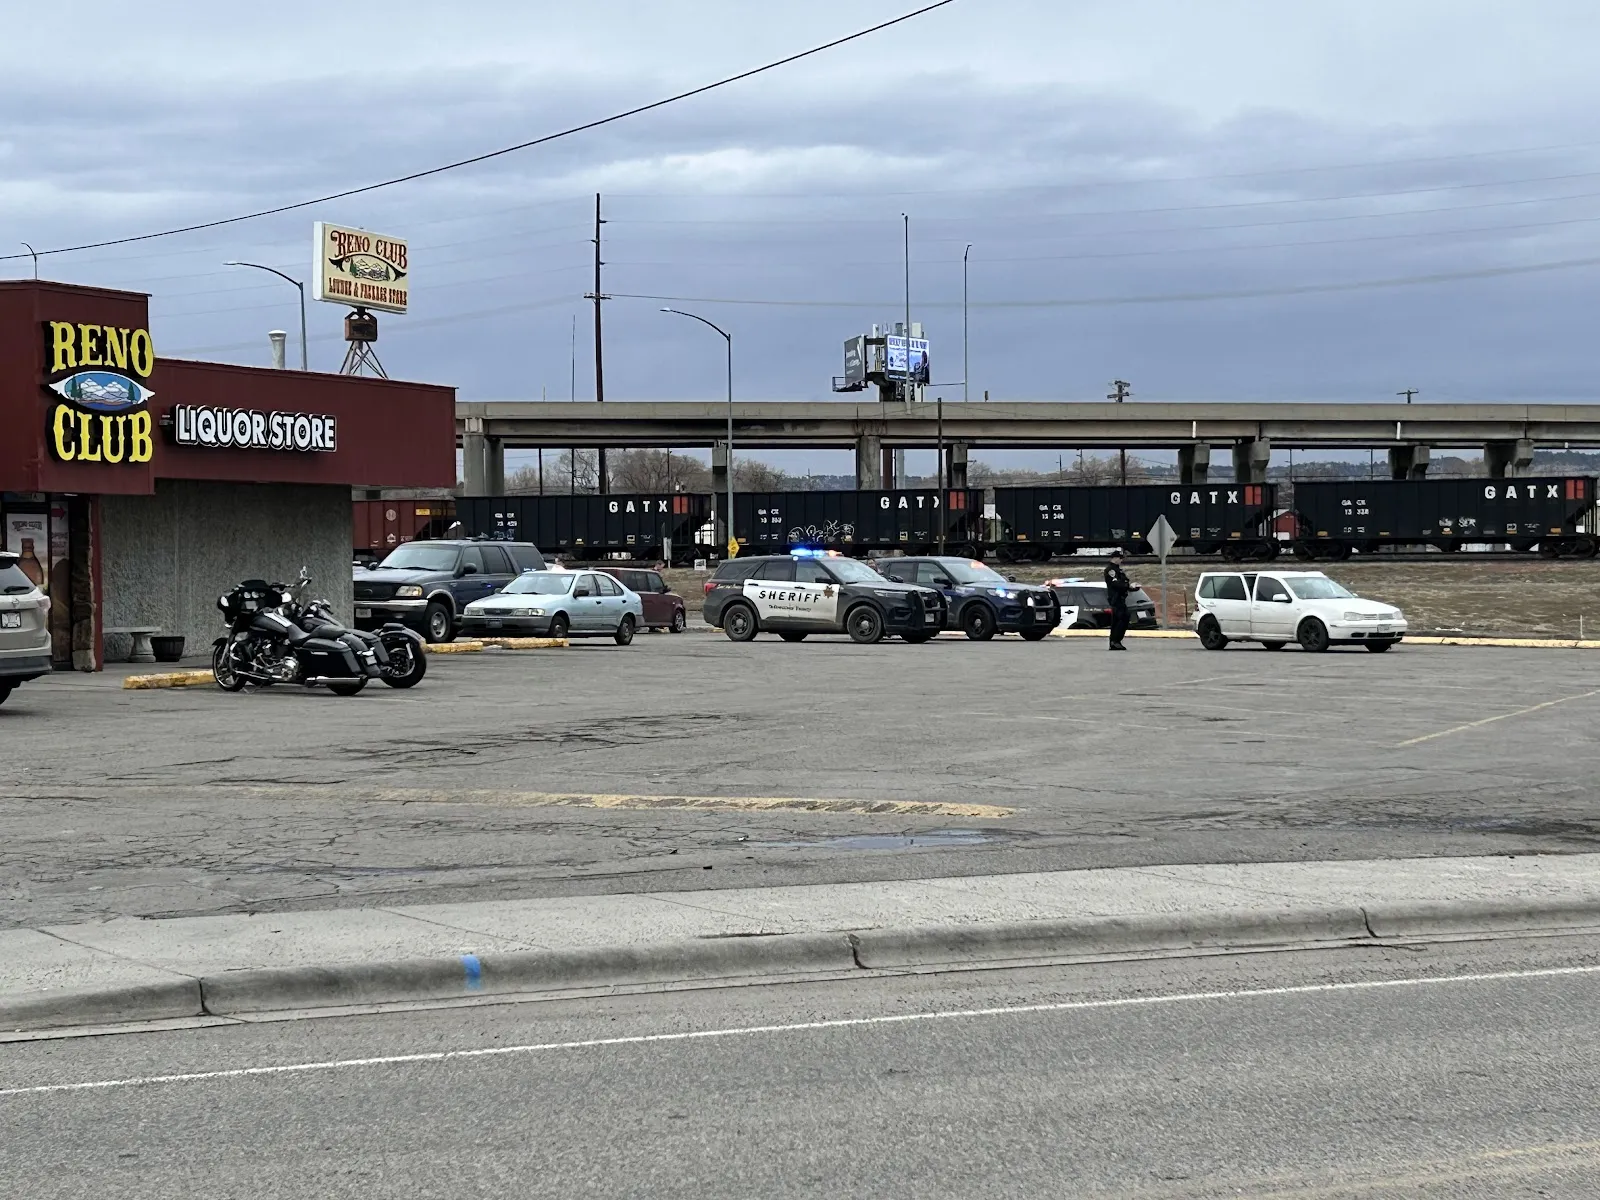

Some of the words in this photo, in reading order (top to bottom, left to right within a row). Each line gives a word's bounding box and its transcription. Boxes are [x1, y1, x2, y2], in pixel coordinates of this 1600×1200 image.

[330, 230, 370, 260] RENO
[376, 239, 408, 269] CLUB
[50, 321, 154, 377] RENO
[53, 405, 154, 463] CLUB
[177, 404, 268, 448] LIQUOR
[270, 411, 336, 451] STORE
[1170, 490, 1239, 505] GATX
[1484, 484, 1559, 500] GATX
[608, 499, 668, 514] GATX
[758, 589, 822, 604] SHERIFF
